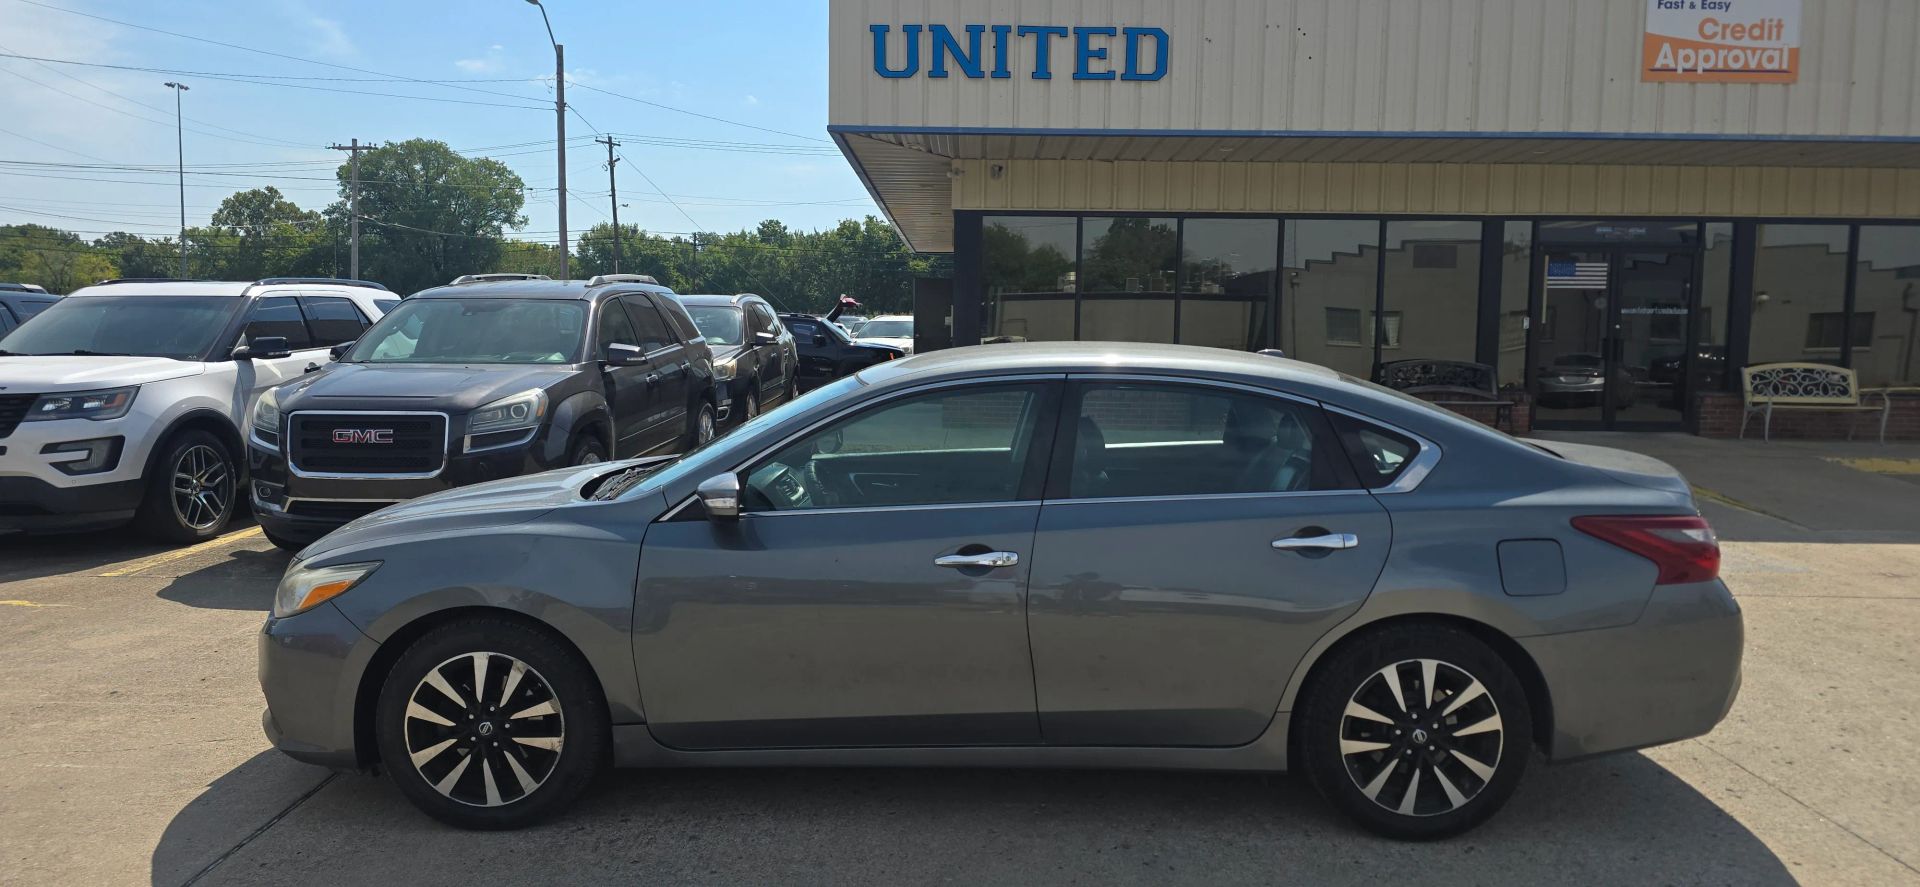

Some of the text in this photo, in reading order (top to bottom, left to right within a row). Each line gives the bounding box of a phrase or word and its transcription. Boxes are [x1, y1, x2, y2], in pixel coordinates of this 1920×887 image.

[1657, 0, 1731, 12] Fast & Easy
[1698, 17, 1784, 41] Credit
[870, 24, 1169, 81] UNITED
[1653, 42, 1790, 74] Approval
[332, 429, 394, 443] GMC
